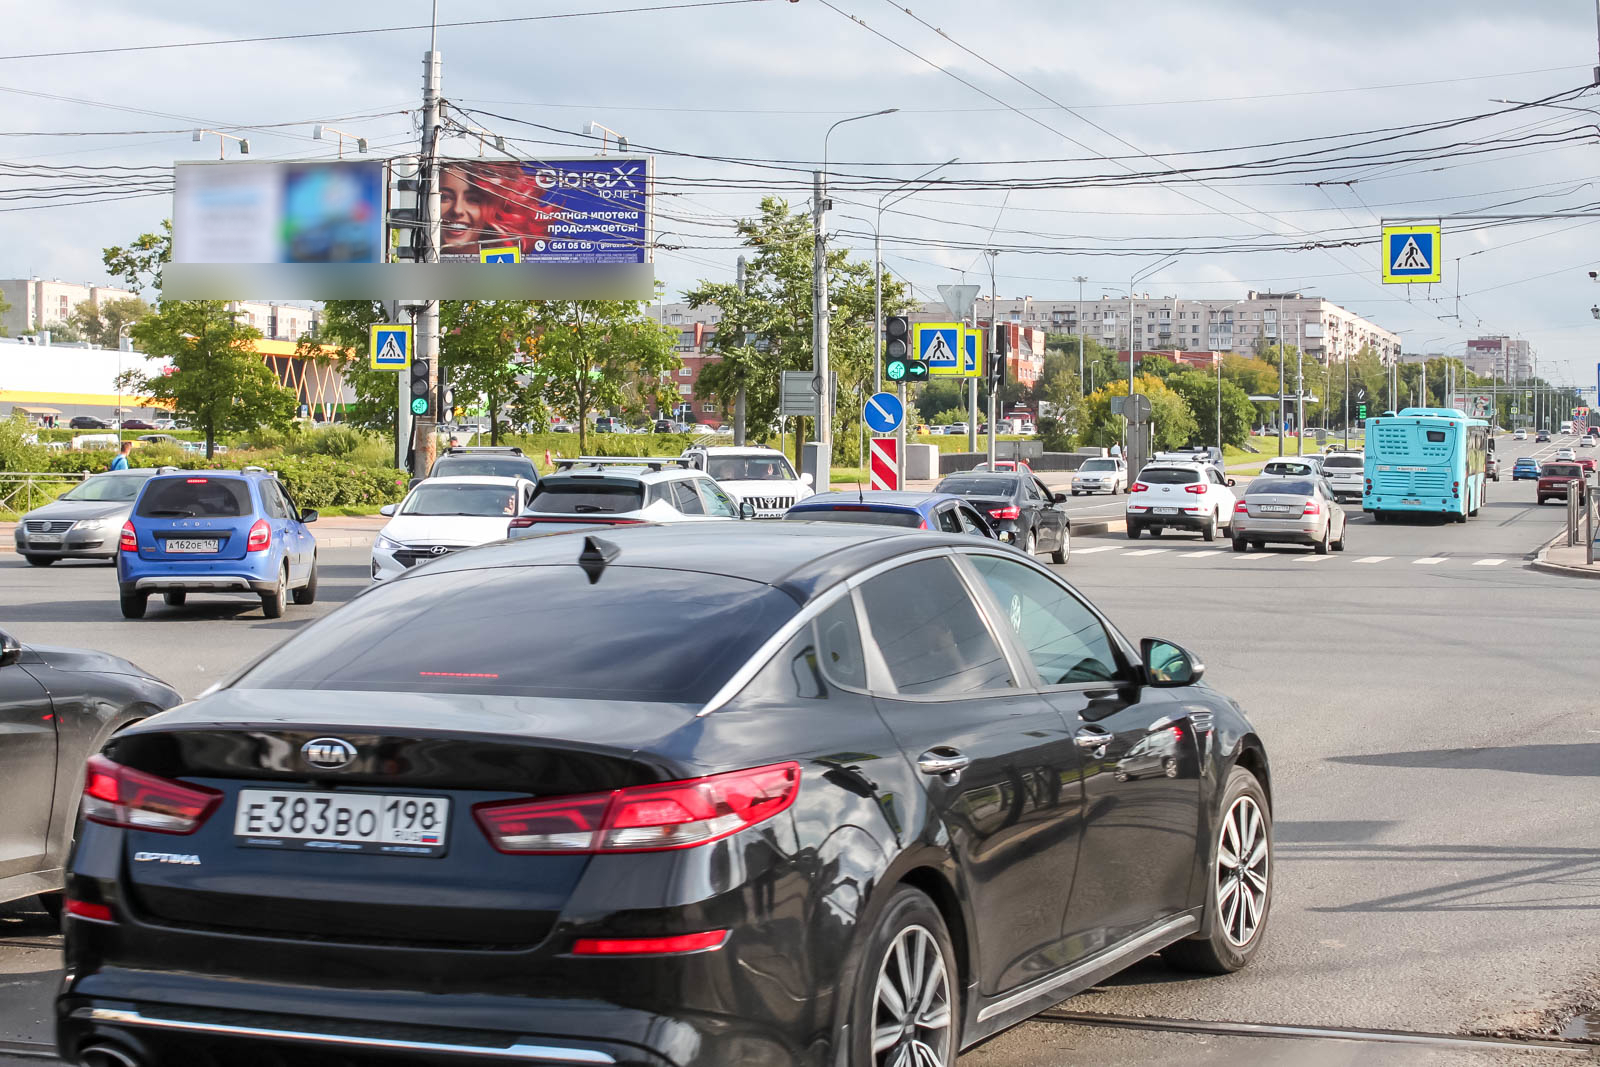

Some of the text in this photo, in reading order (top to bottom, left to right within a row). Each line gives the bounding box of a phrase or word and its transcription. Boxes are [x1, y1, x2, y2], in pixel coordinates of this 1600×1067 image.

[535, 167, 639, 188] GloraX
[598, 190, 639, 199] 10 ЛЕТ
[534, 211, 639, 220] Льготная ипотека
[547, 222, 638, 235] продолжается!
[308, 745, 347, 763] KIA
[247, 796, 437, 837] Е383ВО 198
[134, 851, 201, 865] OPTIMA
